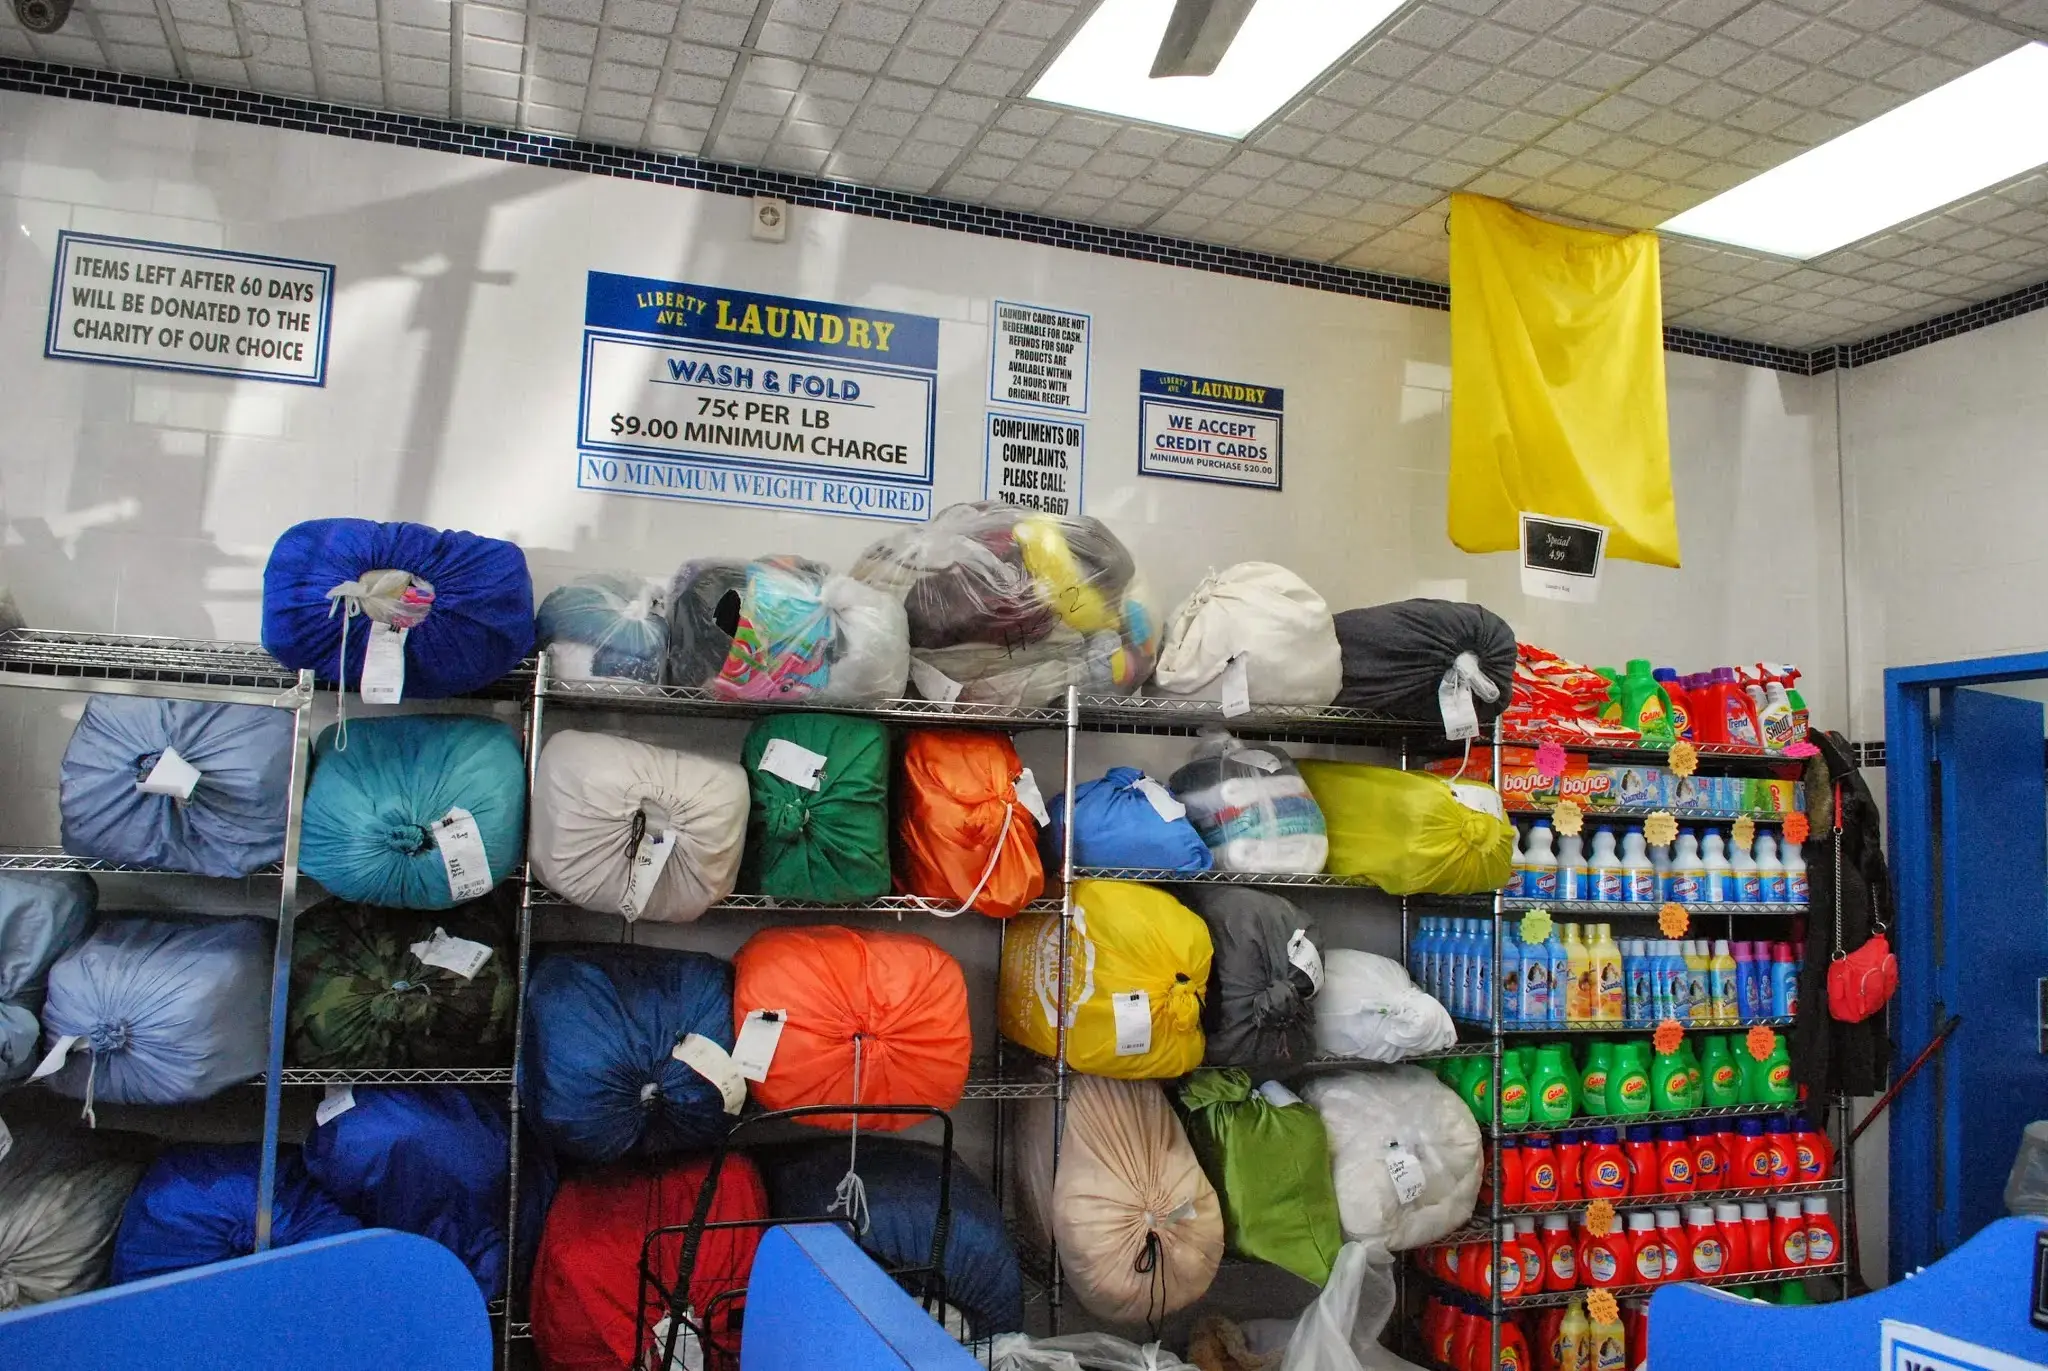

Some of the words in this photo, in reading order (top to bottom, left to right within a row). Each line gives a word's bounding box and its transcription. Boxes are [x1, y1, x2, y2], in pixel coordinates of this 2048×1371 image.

[75, 257, 129, 281] ITEMS
[136, 264, 176, 286] LEFT
[180, 269, 235, 294] AFTER
[240, 277, 262, 297] 60
[268, 280, 313, 302] DAYS
[72, 288, 115, 311] WILL
[122, 293, 144, 313] BE
[152, 296, 240, 324] DONATED
[247, 307, 270, 328] TO
[277, 310, 311, 332] THE
[637, 291, 708, 316] LIBERTY
[657, 310, 687, 327] AVE.
[715, 300, 895, 351] LAUNDRY
[1000, 307, 1031, 321] LAUNDRY
[1033, 312, 1056, 326] CARDS
[1057, 316, 1070, 328] ARE
[1071, 319, 1085, 330] NOT
[73, 318, 153, 343] CHARITY
[158, 328, 183, 348] OF
[190, 332, 230, 354] OUR
[235, 337, 304, 362] CHOICE
[1003, 321, 1046, 336] REDEEMABLE
[1048, 328, 1060, 339] FOR
[1062, 330, 1082, 342] CASH.
[1009, 335, 1039, 349] REFUNDS
[1042, 341, 1054, 351] FOR
[1056, 343, 1074, 354] SOAP
[1015, 349, 1052, 364] PRODUCTS
[1054, 355, 1066, 366] ARE
[667, 359, 753, 389] WASH
[762, 371, 780, 393] &
[789, 373, 861, 402] FOLD
[1009, 361, 1045, 376] AVAILABLE
[1046, 367, 1072, 380] WITHIN
[1013, 375, 1021, 385] 24
[1023, 376, 1047, 390] HOURS
[1049, 381, 1067, 392] WITH
[1192, 380, 1266, 404] LAUNDRY
[1008, 388, 1040, 401] ORIGINAL
[1042, 393, 1070, 406] RECEIPT.
[698, 397, 738, 421] 75¢
[745, 403, 790, 425] PER
[801, 408, 830, 429] LB
[993, 418, 1063, 445] COMPLIMENTS
[1066, 428, 1079, 447] OR
[1169, 414, 1192, 429] WE
[1198, 419, 1256, 438] ACCEPT
[610, 413, 677, 439] $9.00
[685, 421, 804, 453] MINIMUM
[811, 437, 908, 464] CHARGE
[1156, 434, 1211, 453] CREDIT
[1217, 442, 1267, 460] CARDS
[1003, 443, 1068, 471] COMPLAINTS,
[1150, 453, 1194, 465] MINIMUM
[1196, 459, 1241, 471] PURCHASE
[1244, 464, 1272, 474] $20.00
[586, 459, 618, 481] NO
[624, 463, 727, 492] MINIMUM
[734, 473, 817, 501] WEIGHT
[823, 482, 924, 512] REQUIRED
[1003, 468, 1038, 489] PLEASE
[1041, 472, 1065, 492] CALL:
[1546, 533, 1571, 547] Special
[1728, 718, 1748, 729] Trend
[1766, 714, 1790, 740] SHOUT
[1504, 774, 1552, 791] bounce
[1563, 776, 1608, 794] bounce
[1600, 1168, 1617, 1180] Tide
[1673, 1164, 1688, 1177] Tide
